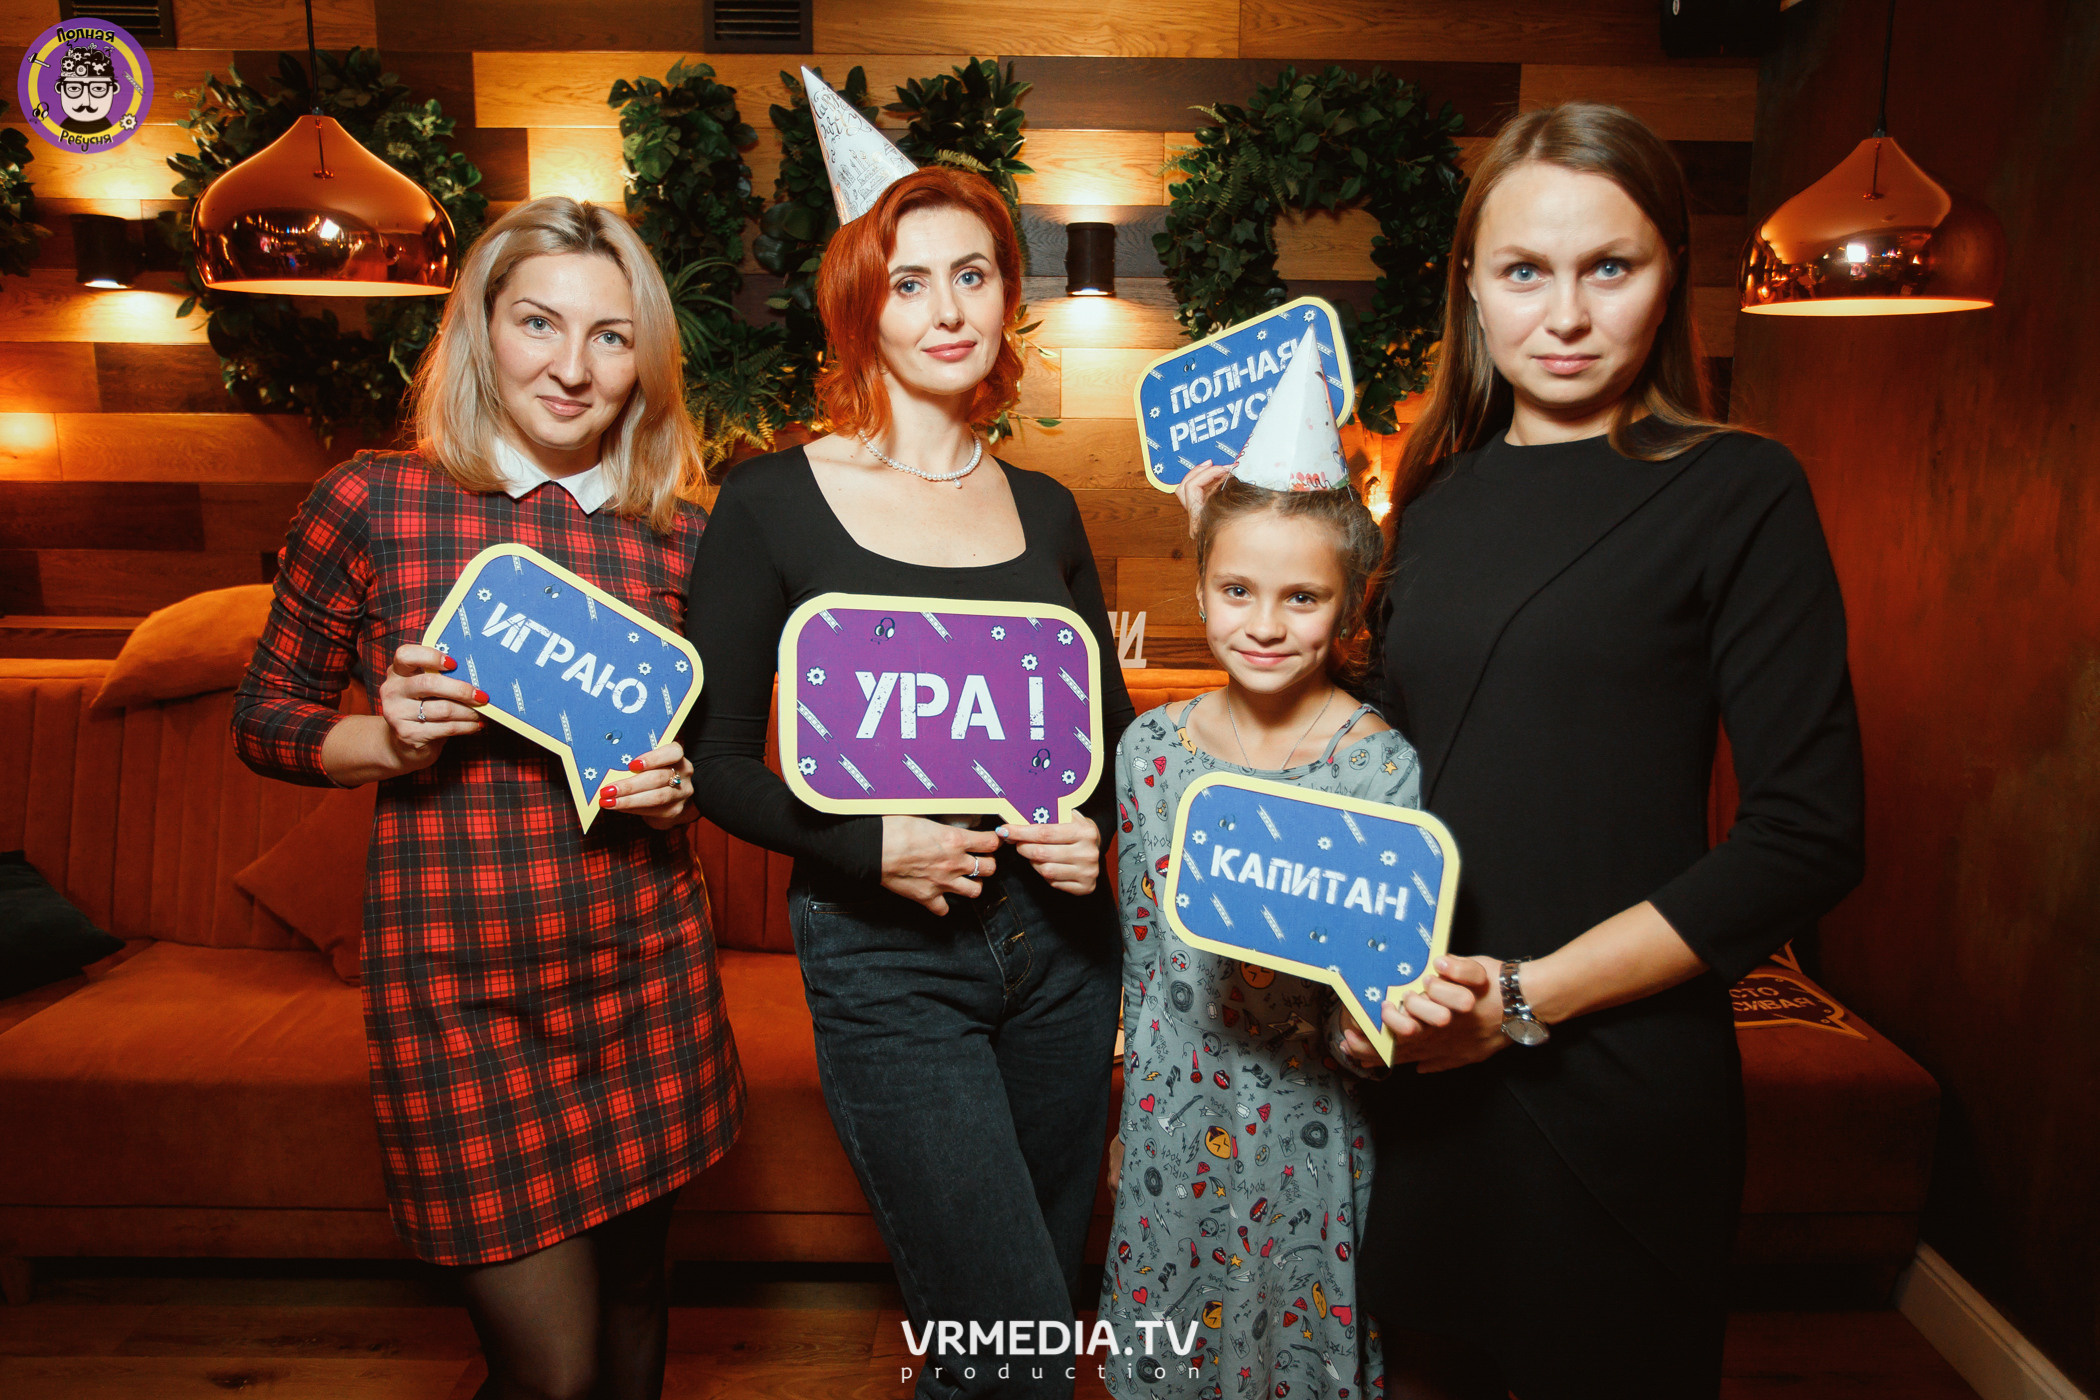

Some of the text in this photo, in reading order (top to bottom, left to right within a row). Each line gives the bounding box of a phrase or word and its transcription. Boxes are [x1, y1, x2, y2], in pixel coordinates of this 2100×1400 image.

[1170, 338, 1298, 414] ПОЛНАЯ
[1170, 387, 1275, 451] РЕБУС
[481, 602, 647, 714] ИГРАЮ
[855, 671, 1005, 740] УРА
[1210, 844, 1408, 921] КАПИТАН
